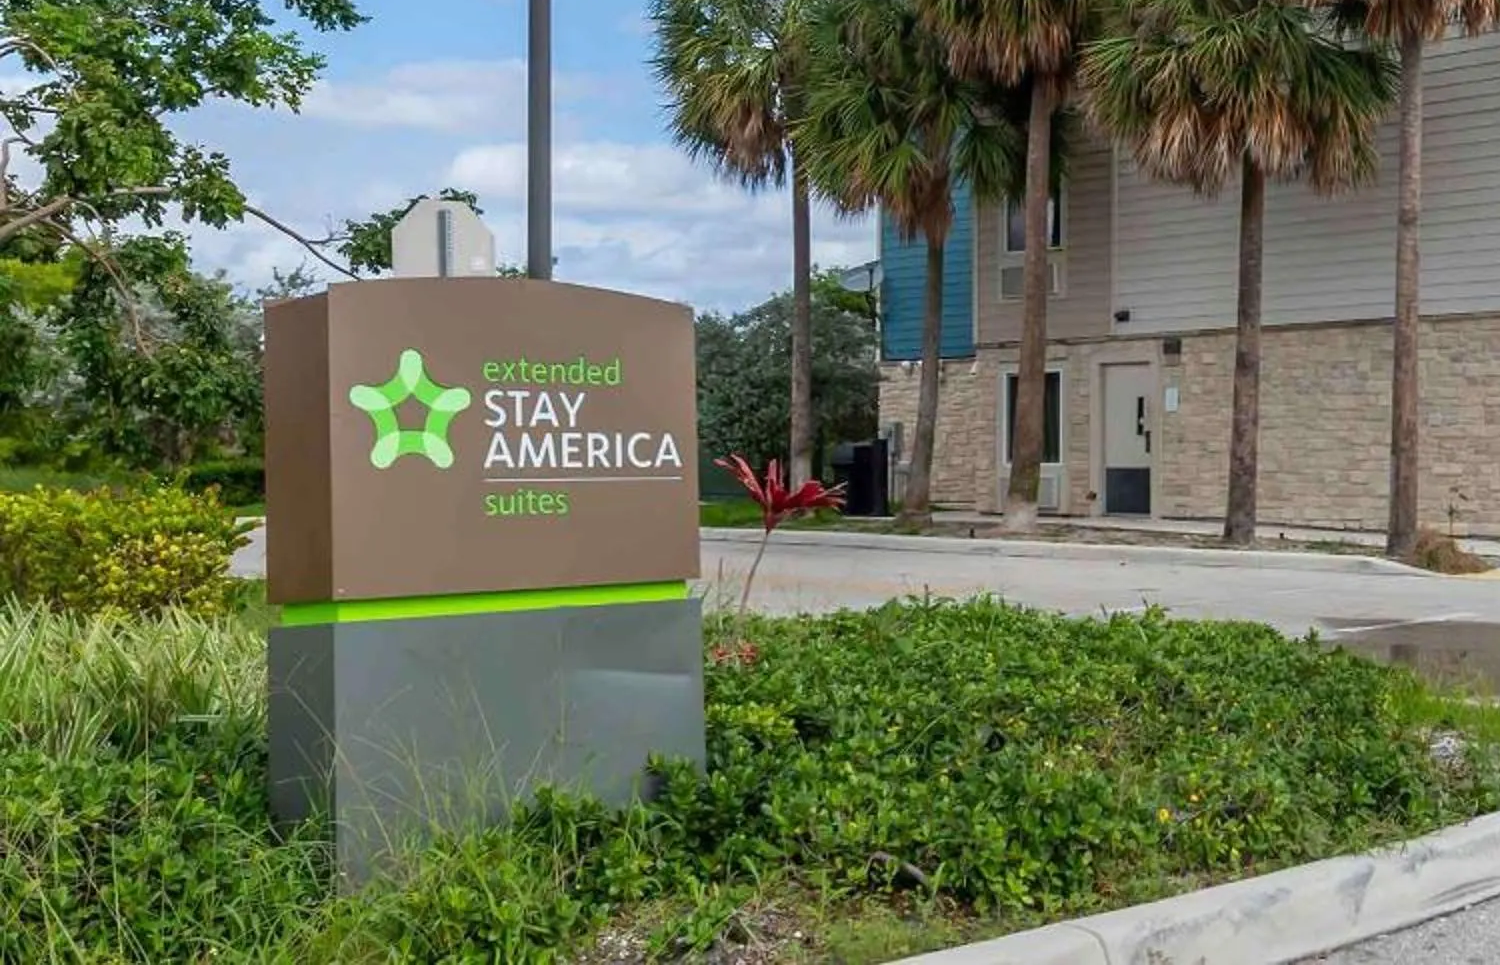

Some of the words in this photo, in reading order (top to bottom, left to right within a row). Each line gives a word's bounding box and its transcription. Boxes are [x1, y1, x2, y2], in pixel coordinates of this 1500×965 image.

[483, 356, 622, 385] extended
[484, 389, 585, 427] STAY
[484, 432, 683, 469] AMERICA
[484, 489, 570, 516] suites
